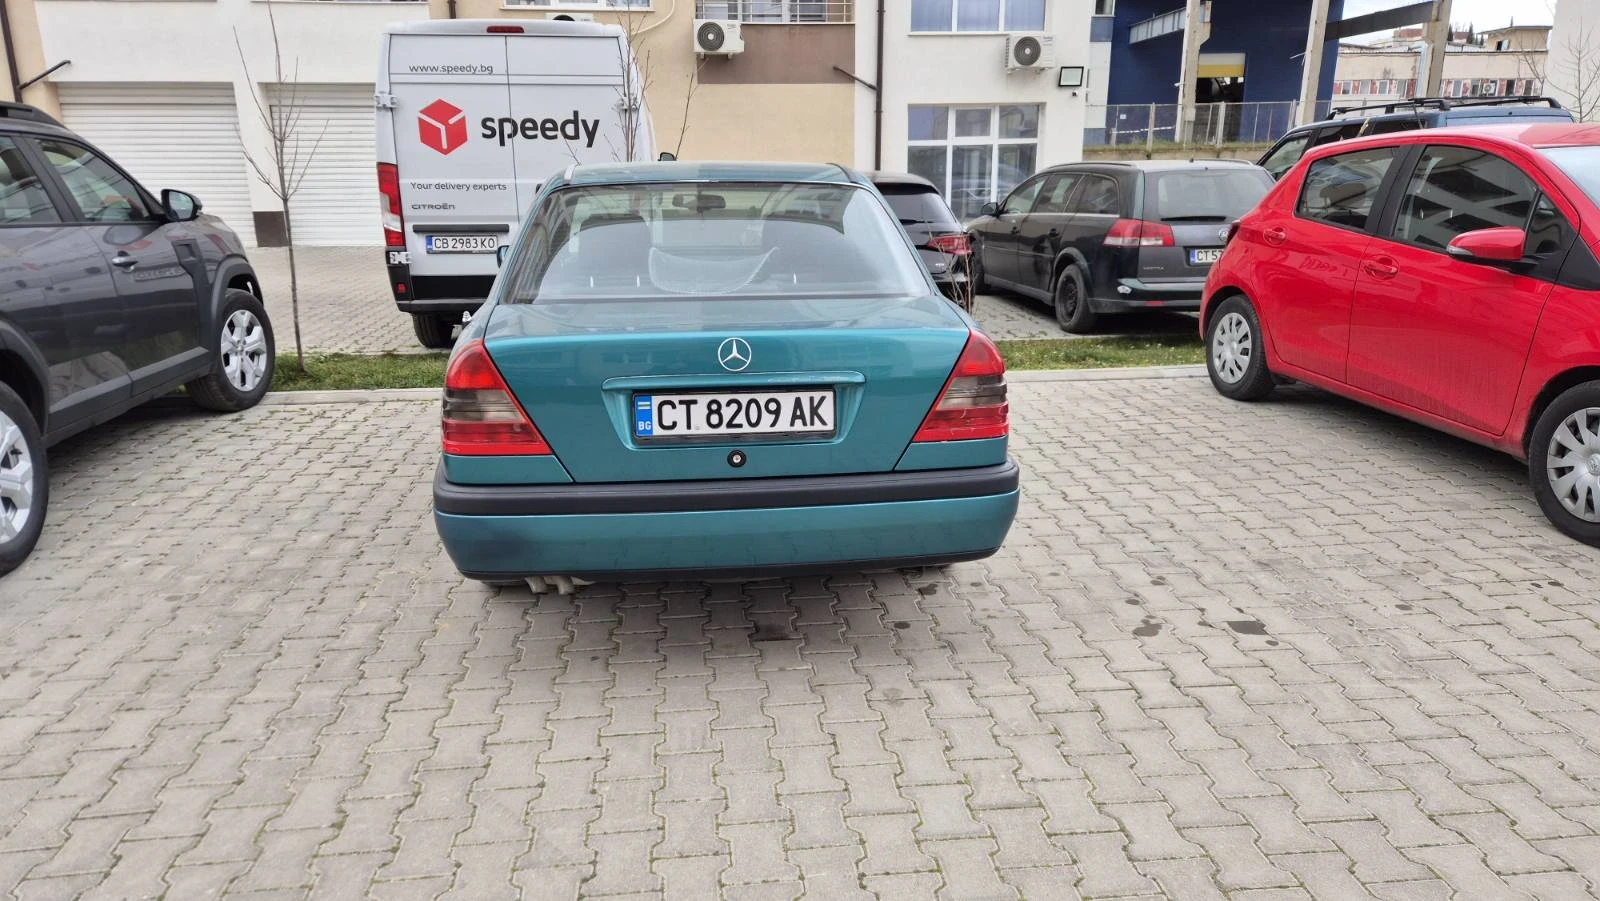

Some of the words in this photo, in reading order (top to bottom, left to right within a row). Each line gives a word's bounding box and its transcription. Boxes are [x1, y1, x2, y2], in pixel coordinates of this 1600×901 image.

[408, 64, 494, 75] www.speedy.bg
[480, 110, 600, 148] speedy
[410, 182, 433, 190] Your
[434, 182, 471, 192] delivery
[472, 183, 507, 192] experts
[434, 238, 449, 249] CB
[451, 238, 479, 249] 2983
[657, 399, 699, 431] CT
[705, 397, 782, 430] 8209
[789, 395, 829, 427] AK
[638, 421, 652, 431] BG
